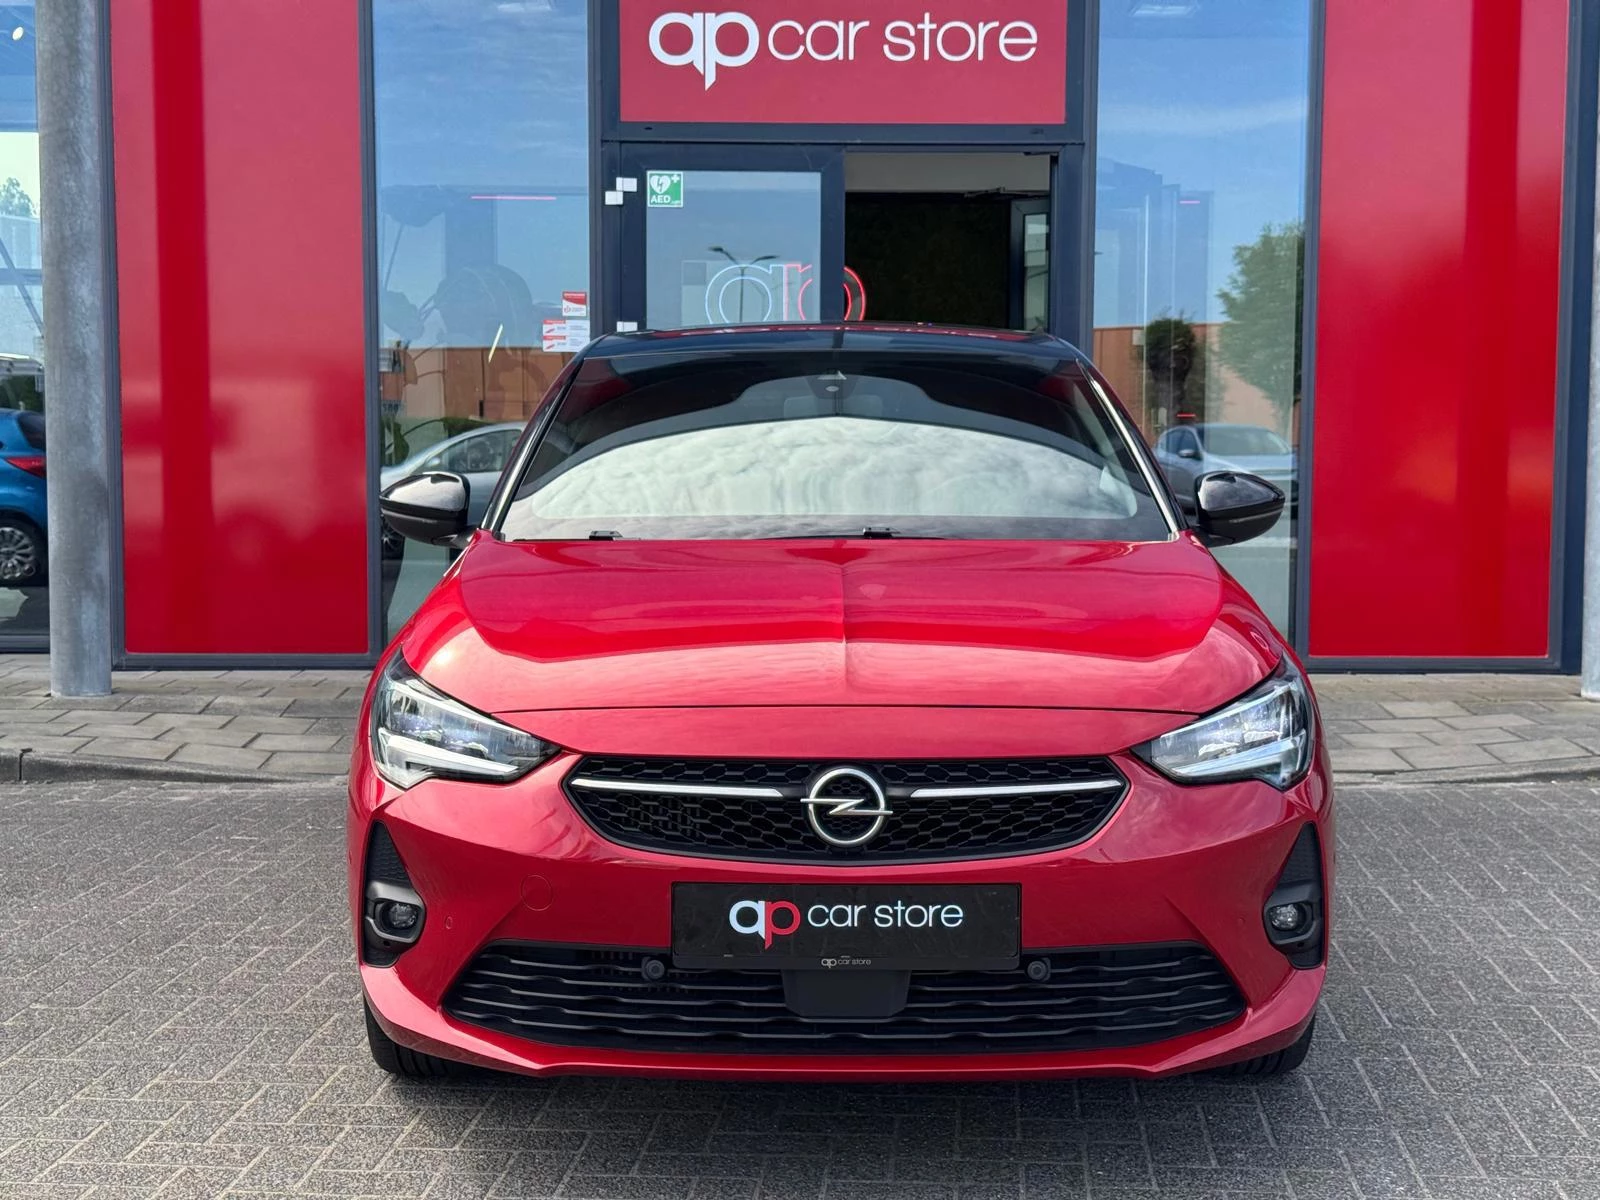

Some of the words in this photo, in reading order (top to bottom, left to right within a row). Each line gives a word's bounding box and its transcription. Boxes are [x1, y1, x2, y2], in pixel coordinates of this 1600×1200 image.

[649, 12, 759, 90] ap
[768, 21, 869, 61] car
[883, 13, 1037, 62] store
[651, 194, 671, 204] AED
[729, 900, 800, 949] ap
[808, 904, 866, 928] car
[874, 900, 963, 928] store
